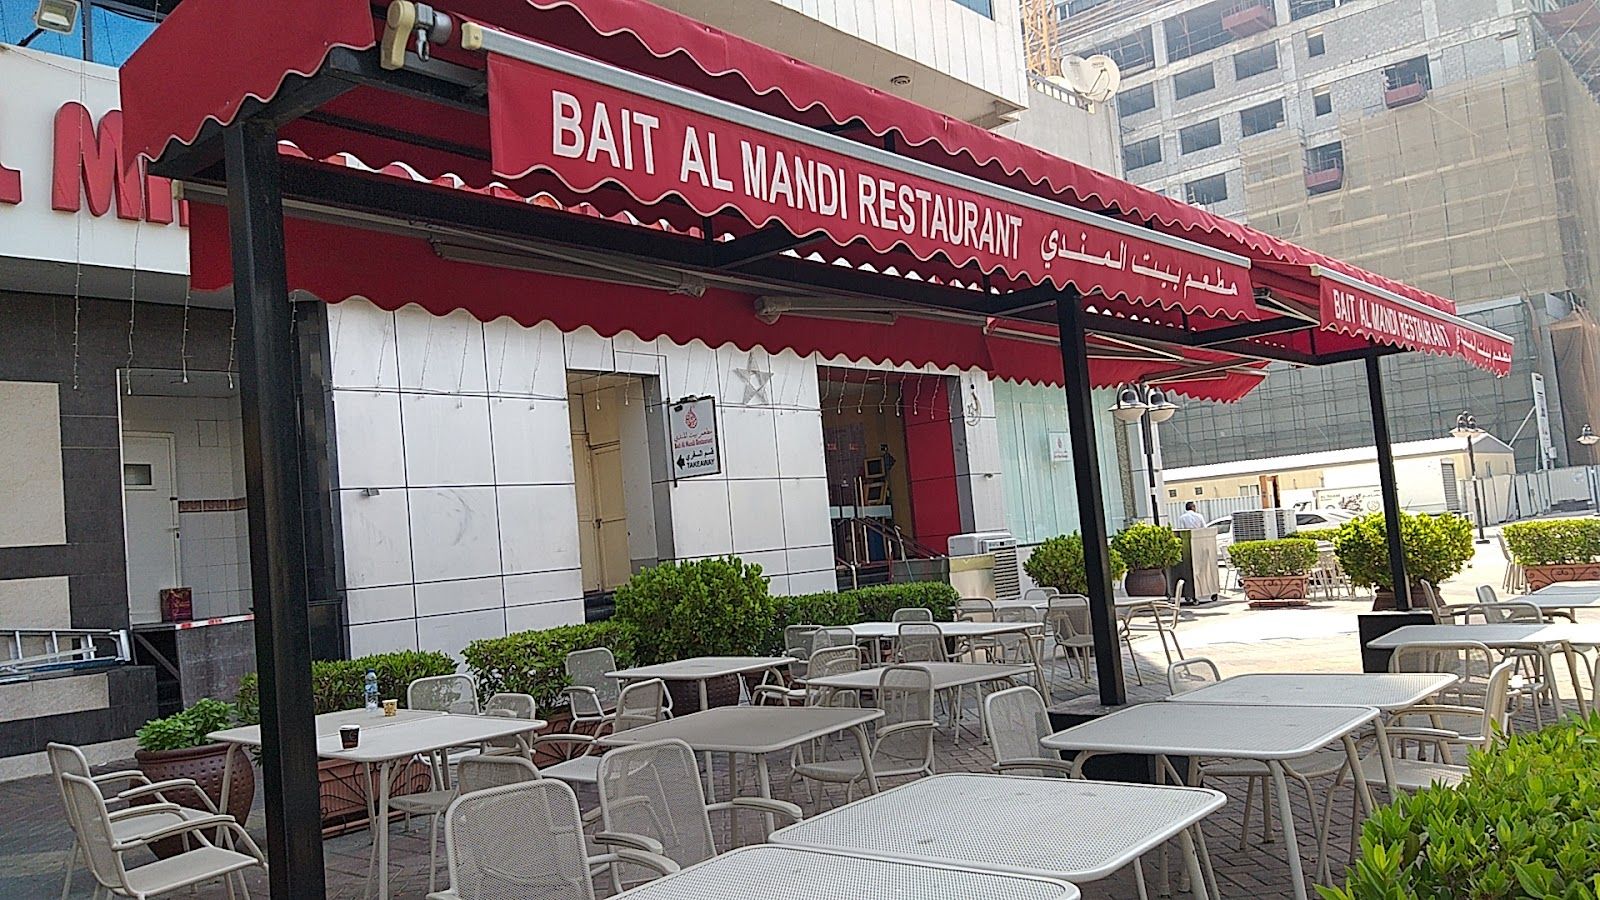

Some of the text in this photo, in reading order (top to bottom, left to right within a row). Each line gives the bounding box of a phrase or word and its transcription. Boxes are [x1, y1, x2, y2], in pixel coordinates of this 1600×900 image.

[552, 90, 1023, 260] BAIT AL MANDI RESTAURANT
[1041, 228, 1239, 299] مطعم بيت المندي
[1333, 289, 1451, 348] BAIT AL MANDI RESTAURANT
[686, 458, 715, 469] TAKEAWAY
